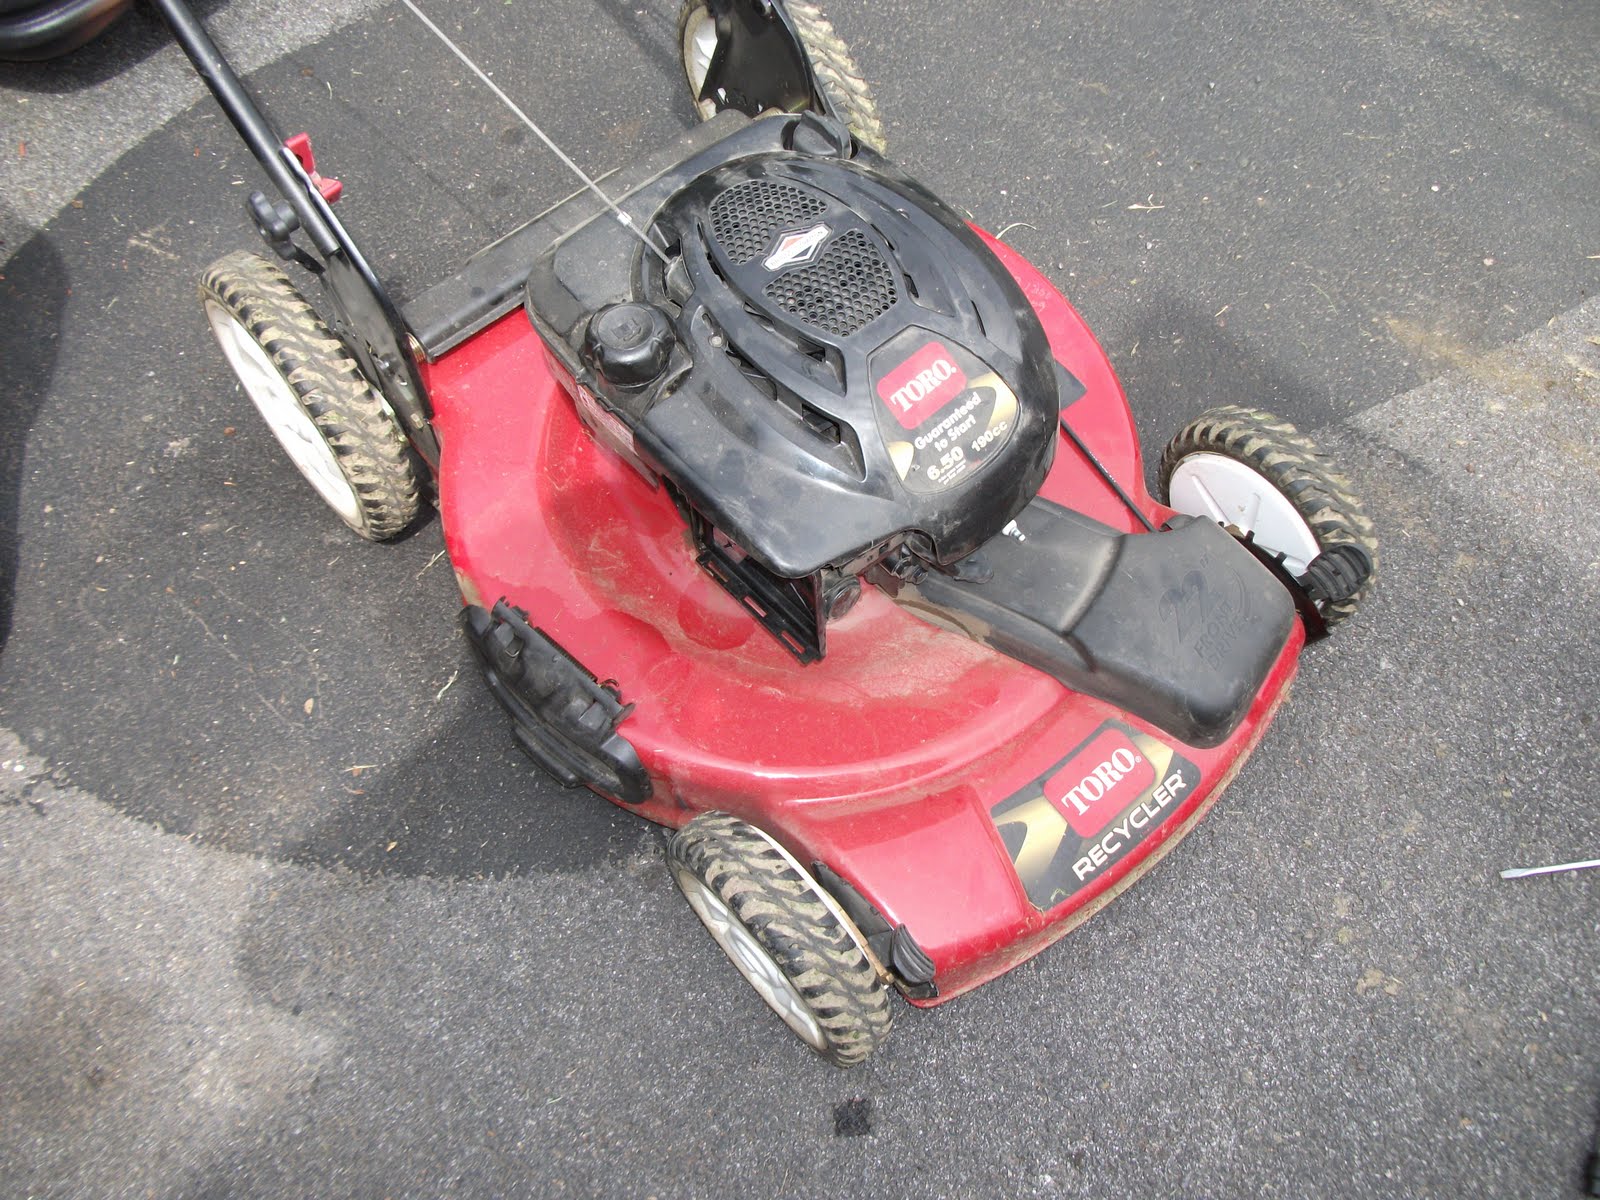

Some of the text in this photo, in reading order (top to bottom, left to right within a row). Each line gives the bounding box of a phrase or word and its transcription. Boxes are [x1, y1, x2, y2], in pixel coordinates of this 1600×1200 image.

[914, 391, 982, 450] Guaranteed
[934, 414, 977, 452] to Start
[971, 421, 1008, 452] 190cc
[927, 446, 964, 480] 6.50
[1193, 600, 1233, 659] FRONT
[1207, 615, 1246, 671] DRIVE
[1072, 769, 1187, 881] RECYCLER
